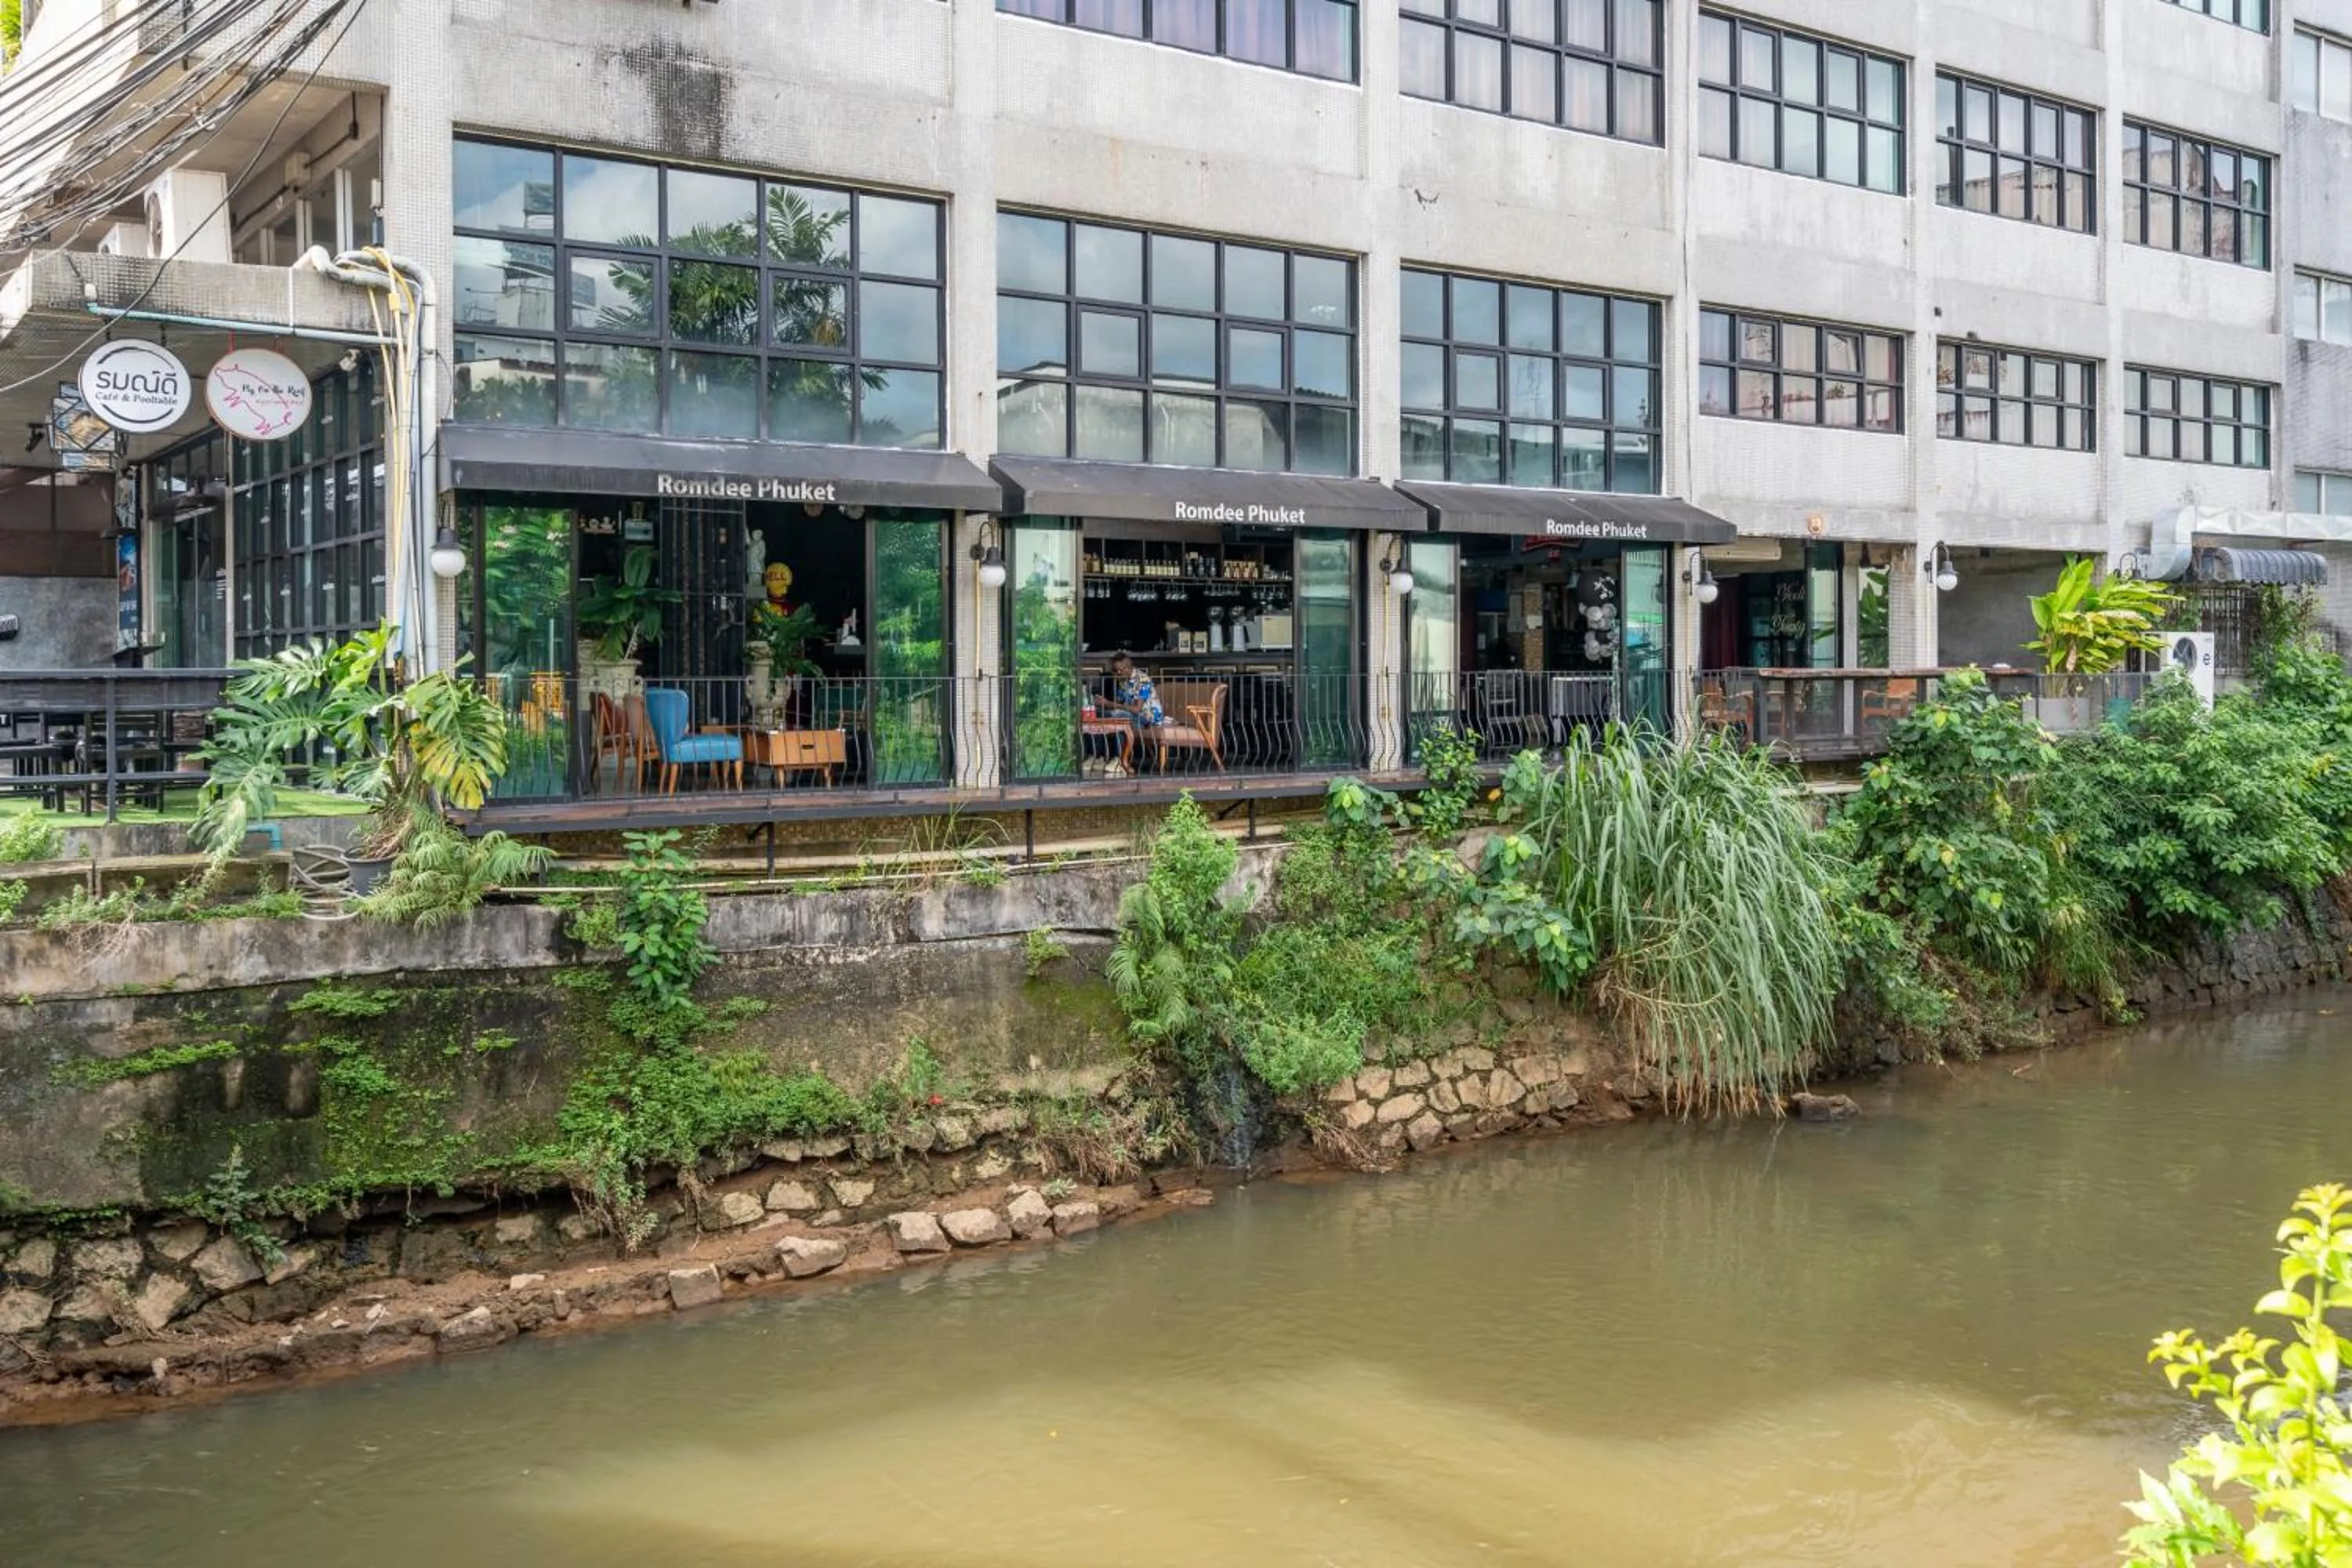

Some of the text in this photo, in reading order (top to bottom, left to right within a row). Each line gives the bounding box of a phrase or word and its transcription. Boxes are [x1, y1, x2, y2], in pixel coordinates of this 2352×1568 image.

[96, 370, 178, 397] รมณ์ดี
[657, 473, 836, 502] Romdee Phuket
[1175, 501, 1306, 524] Romdee Phuket
[1546, 518, 1648, 539] Romdee Phuket
